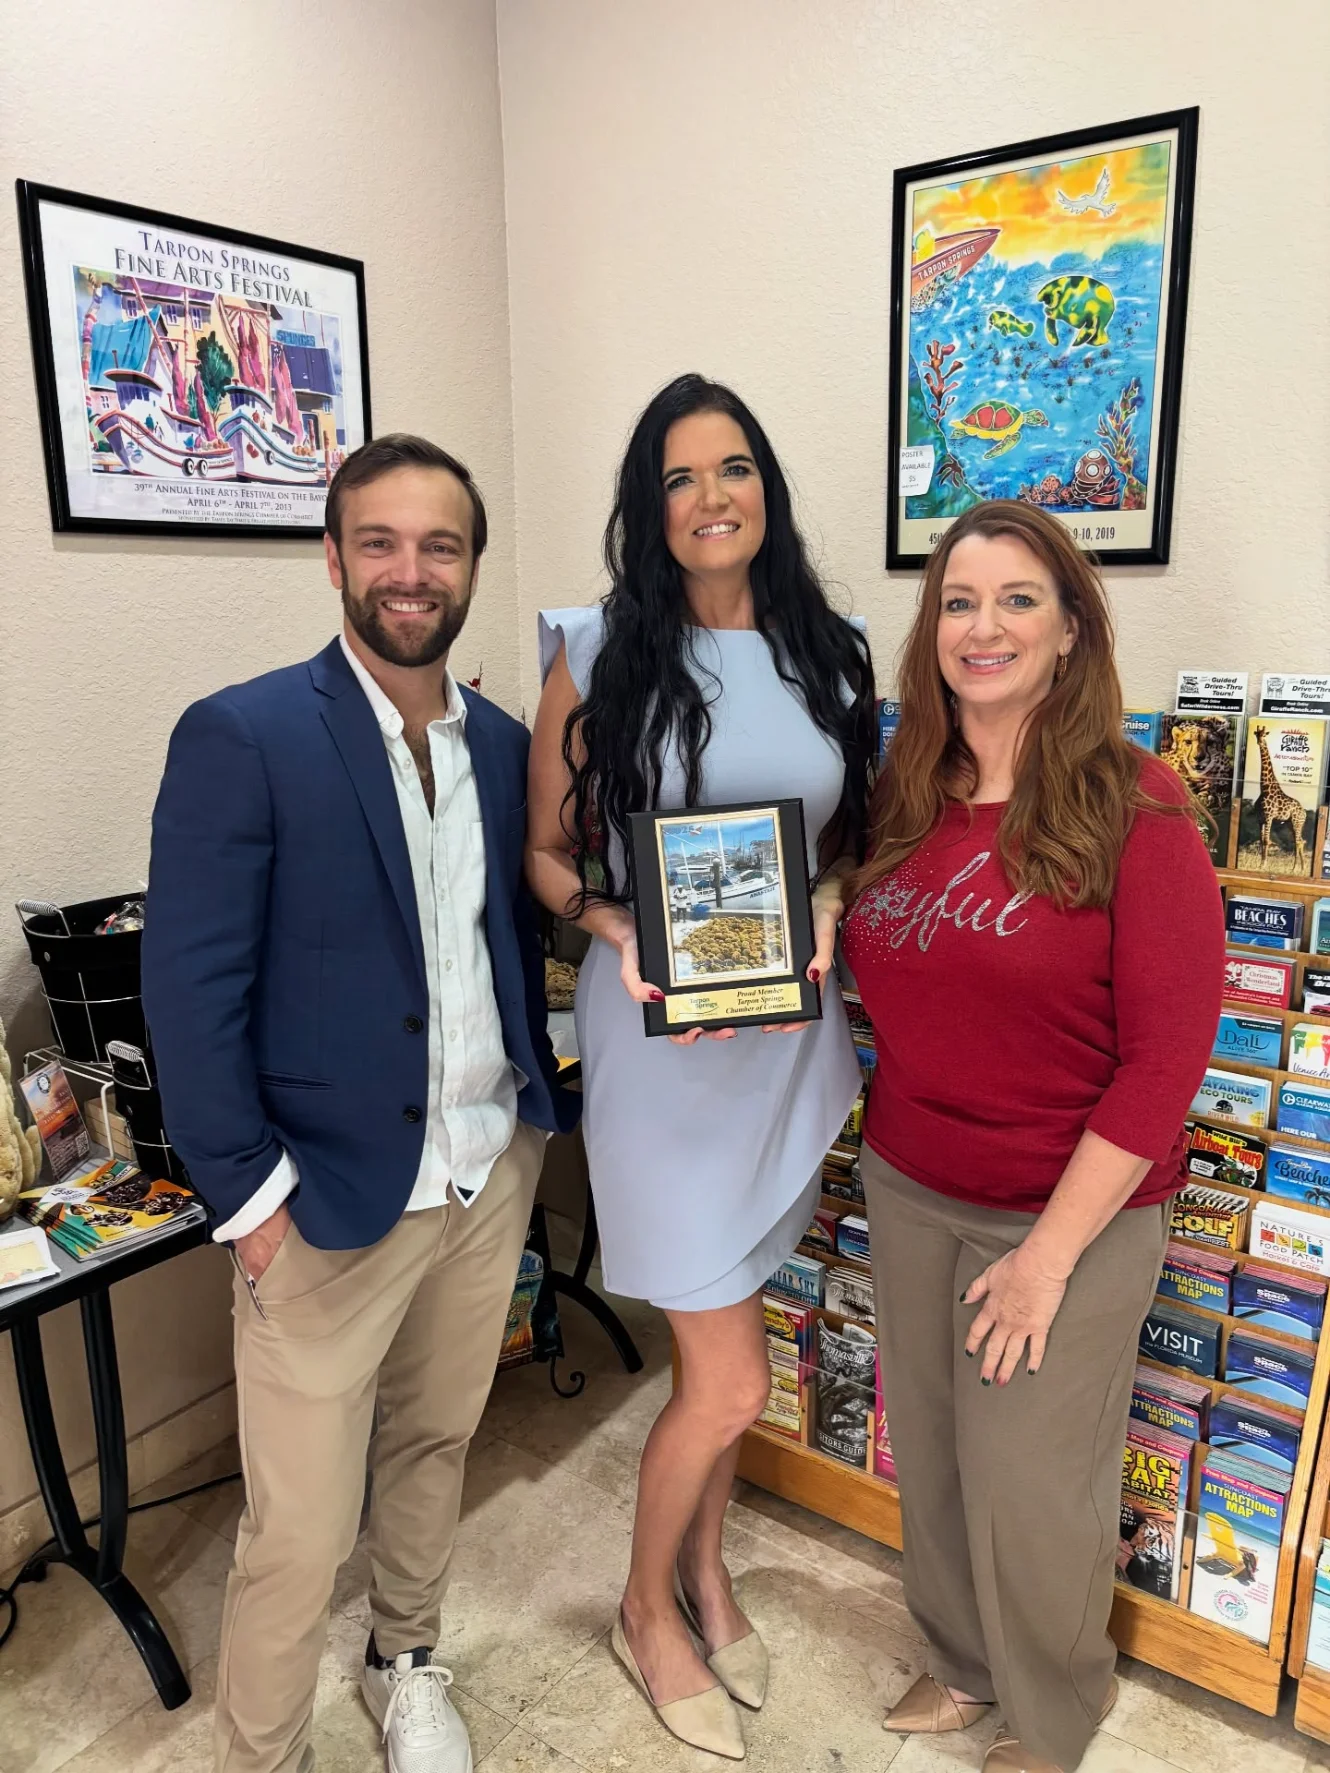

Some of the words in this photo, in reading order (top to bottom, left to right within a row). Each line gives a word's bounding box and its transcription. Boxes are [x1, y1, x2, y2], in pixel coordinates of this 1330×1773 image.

[138, 231, 214, 264] TARPON
[221, 250, 290, 282] SPRINGS
[918, 258, 947, 281] TARPON
[949, 245, 976, 265] SPRINGS
[115, 248, 166, 278] FINE
[173, 262, 224, 290] ARTS
[231, 273, 313, 308] FESTIVAL
[155, 484, 193, 495] ANNUAL
[196, 486, 215, 496] FINE
[218, 488, 239, 497] ARTS
[241, 489, 276, 500] FESTIVAL
[277, 491, 289, 500] ON
[291, 492, 308, 501] THE
[187, 498, 212, 508] APRIL
[234, 500, 258, 510] APRIL
[275, 503, 292, 512] 2013
[1095, 526, 1115, 540] 2019
[1204, 683, 1243, 691] Drive-Thru
[1211, 676, 1238, 684] Guided
[1234, 908, 1287, 926] BEACHES
[737, 989, 757, 998] Proud
[758, 987, 783, 996] Member
[738, 998, 759, 1006] Tarpon
[761, 996, 784, 1004] Springs
[725, 1005, 754, 1014] Chamber
[756, 1004, 763, 1012] of
[1202, 1079, 1260, 1097] AYAKING
[1220, 1091, 1253, 1105] TOURS
[1280, 1126, 1300, 1135] HERE
[1300, 1130, 1317, 1139] OUR
[1275, 1161, 1330, 1187] Beache
[1260, 1239, 1288, 1253] FOOD
[1292, 1249, 1324, 1265] PATCH
[772, 1270, 794, 1289] LEAR
[1160, 1270, 1224, 1297] ATTRACTIONS
[1177, 1284, 1203, 1299] MAP
[1146, 1322, 1204, 1357] VISIT
[1148, 1413, 1174, 1427] MAP
[1122, 1477, 1171, 1499] ABITAT
[1204, 1482, 1277, 1518] ATTRACTIONS
[1226, 1500, 1254, 1518] MAP
